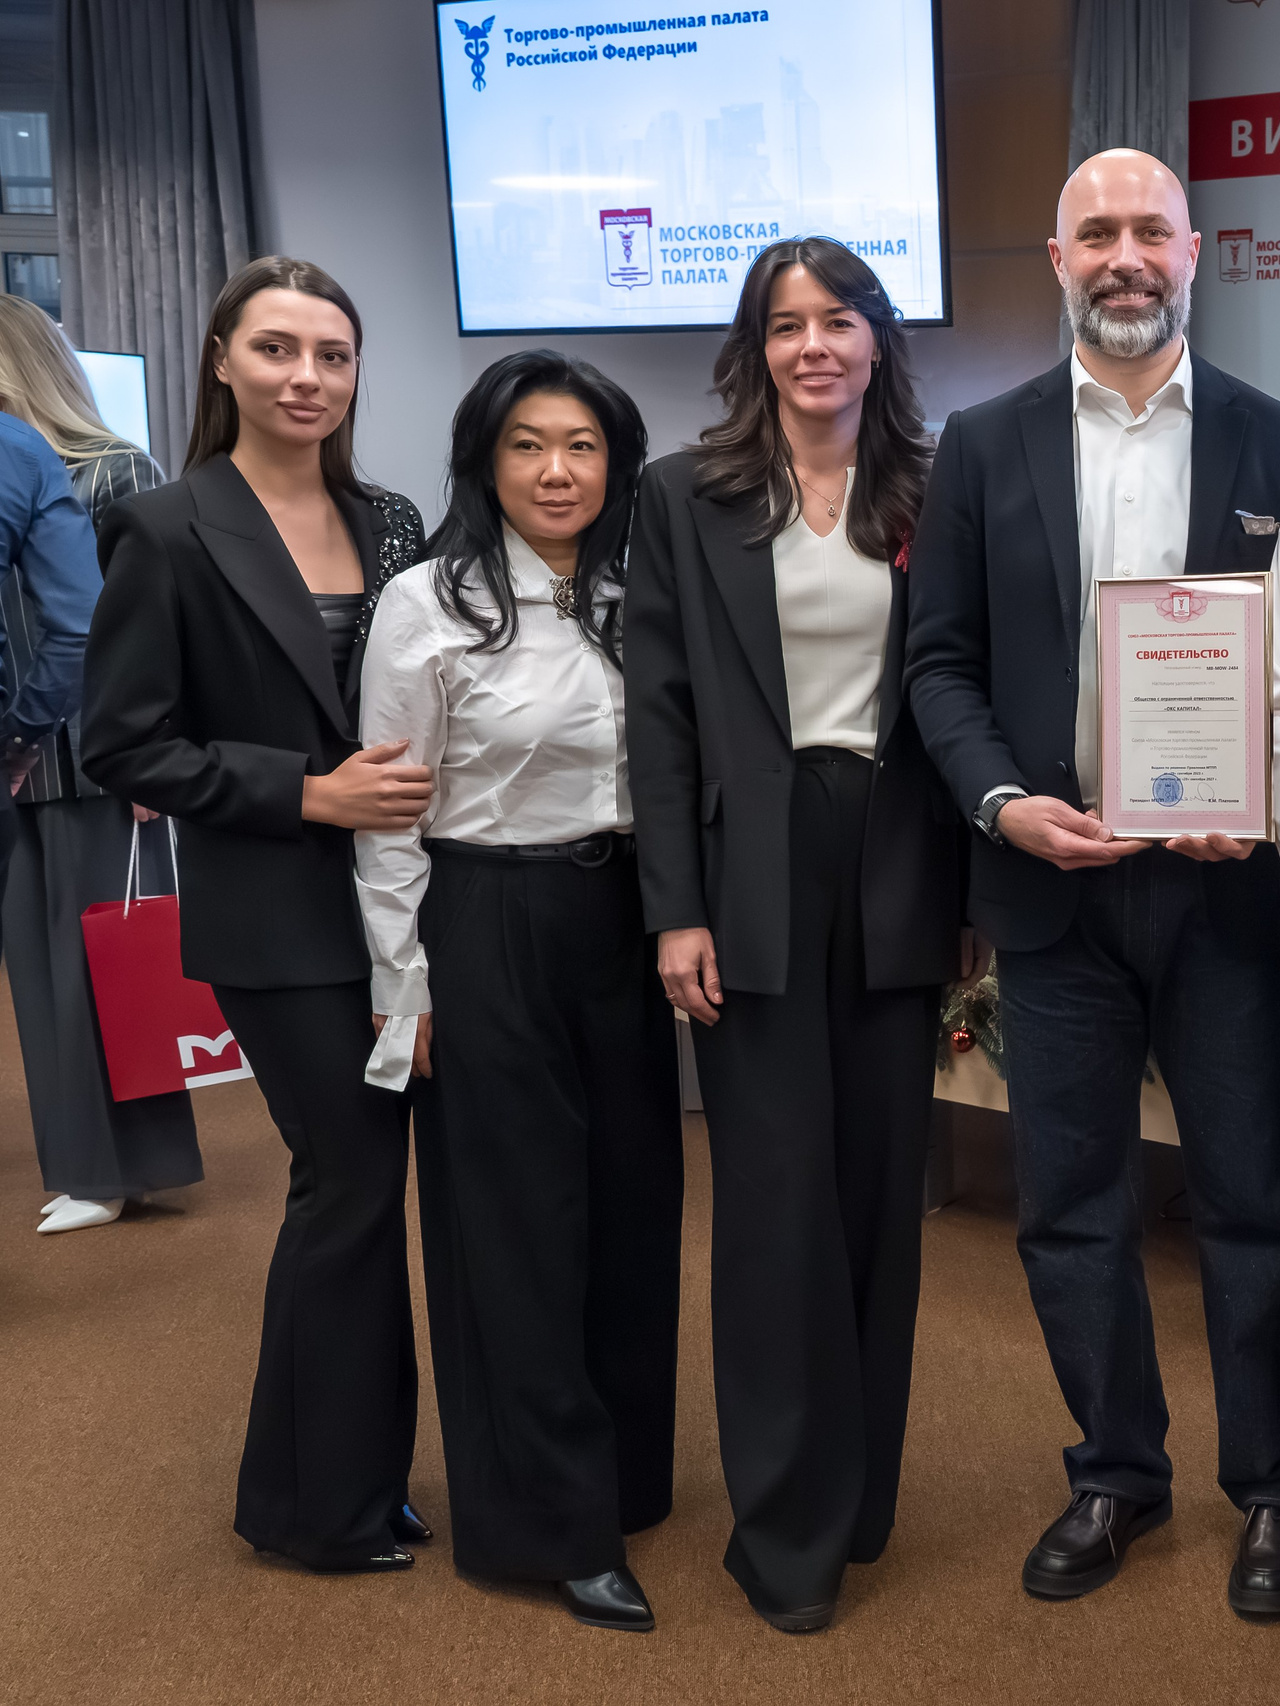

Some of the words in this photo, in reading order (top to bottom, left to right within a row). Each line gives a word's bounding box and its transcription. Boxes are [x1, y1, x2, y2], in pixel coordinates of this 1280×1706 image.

[504, 15, 706, 46] Торгово-промышленная
[711, 9, 769, 27] палата
[506, 45, 598, 67] Российской
[602, 41, 698, 61] Федерации
[1231, 118, 1255, 158] В
[659, 222, 780, 242] МОСКОВСКАЯ
[662, 268, 729, 285] ПАЛАТА
[1136, 649, 1229, 661] СВИДЕТЕЛЬСТВО
